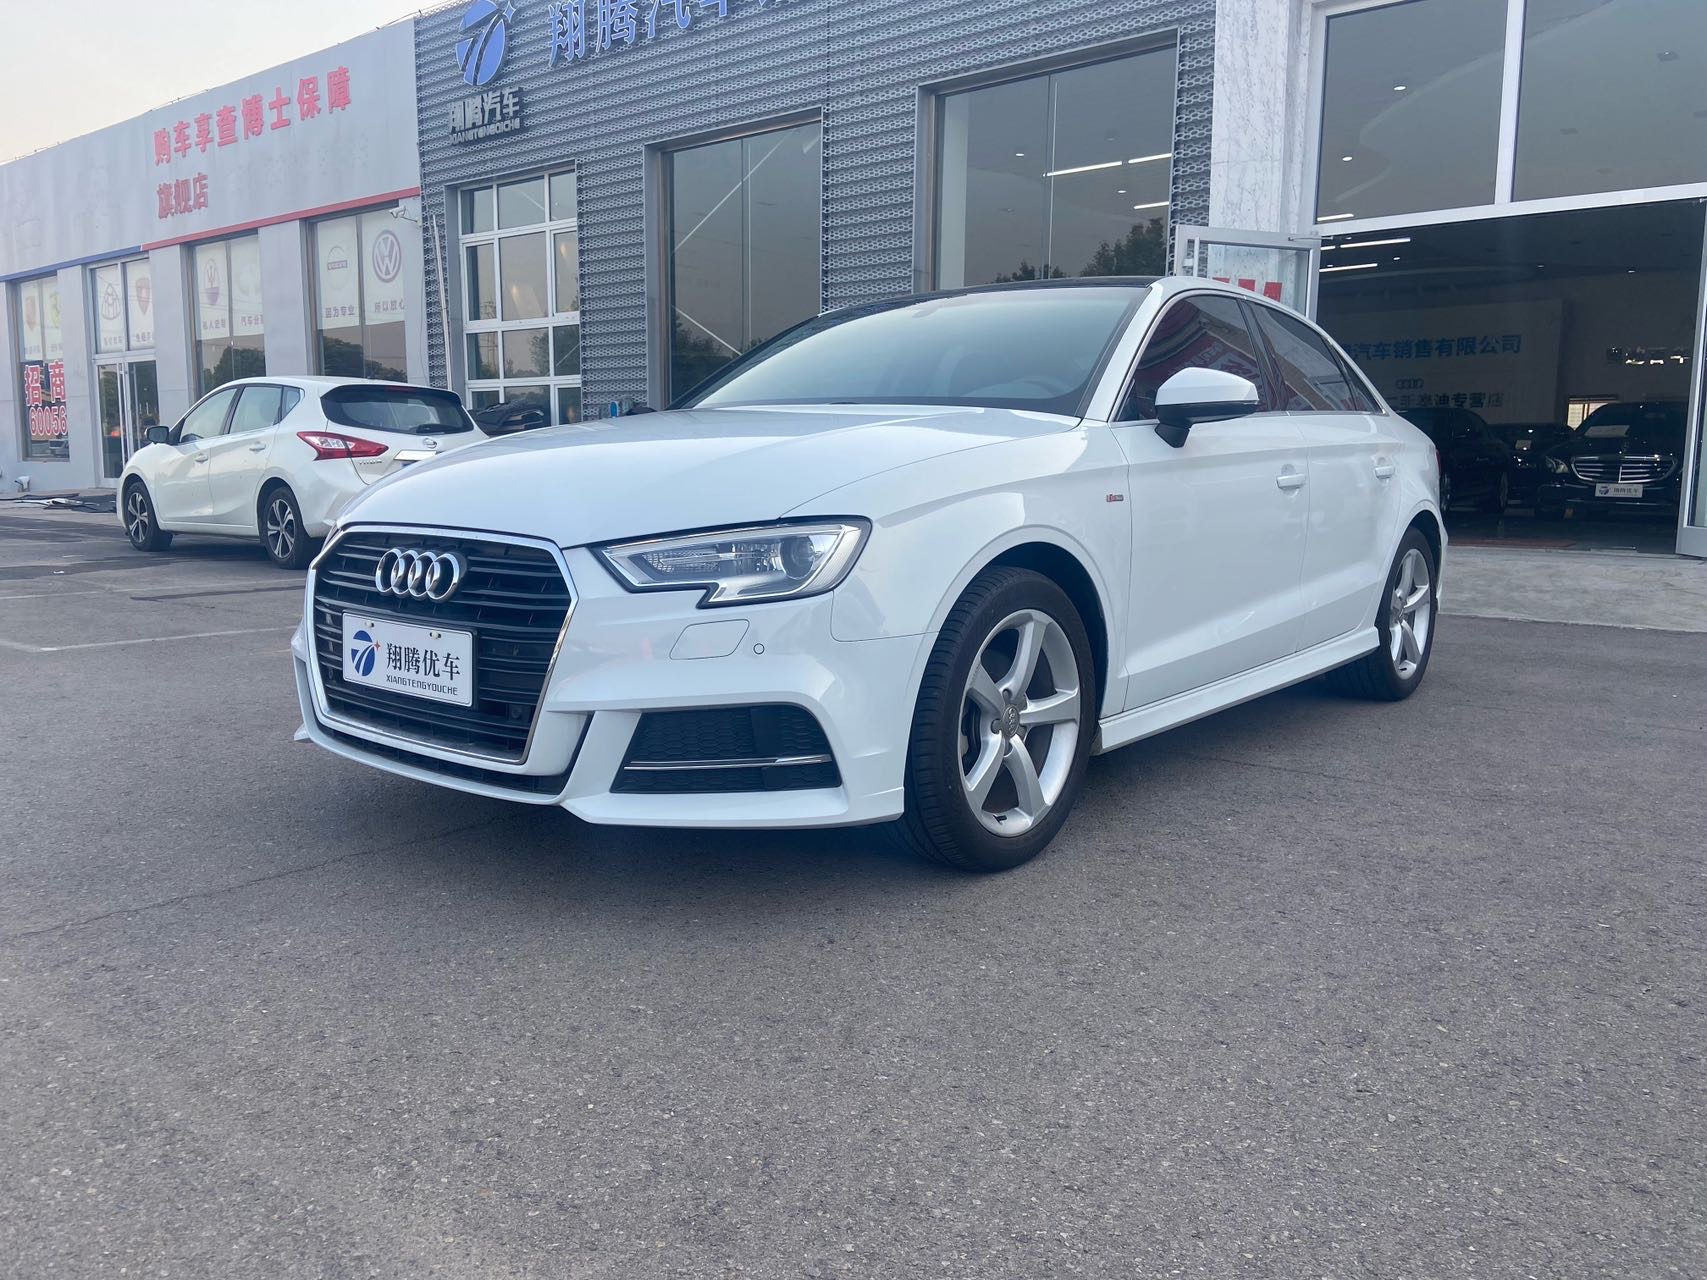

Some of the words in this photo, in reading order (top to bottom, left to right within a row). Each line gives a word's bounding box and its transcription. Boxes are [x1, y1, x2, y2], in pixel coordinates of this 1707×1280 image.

[153, 66, 352, 166] 购车享查博士保障
[448, 86, 520, 133] 翔腾汽车
[156, 172, 209, 220] 旗舰店
[24, 359, 67, 407] 招商
[386, 643, 461, 681] 翔腾优车
[386, 674, 458, 696] XIANGTENGYOUCHE
